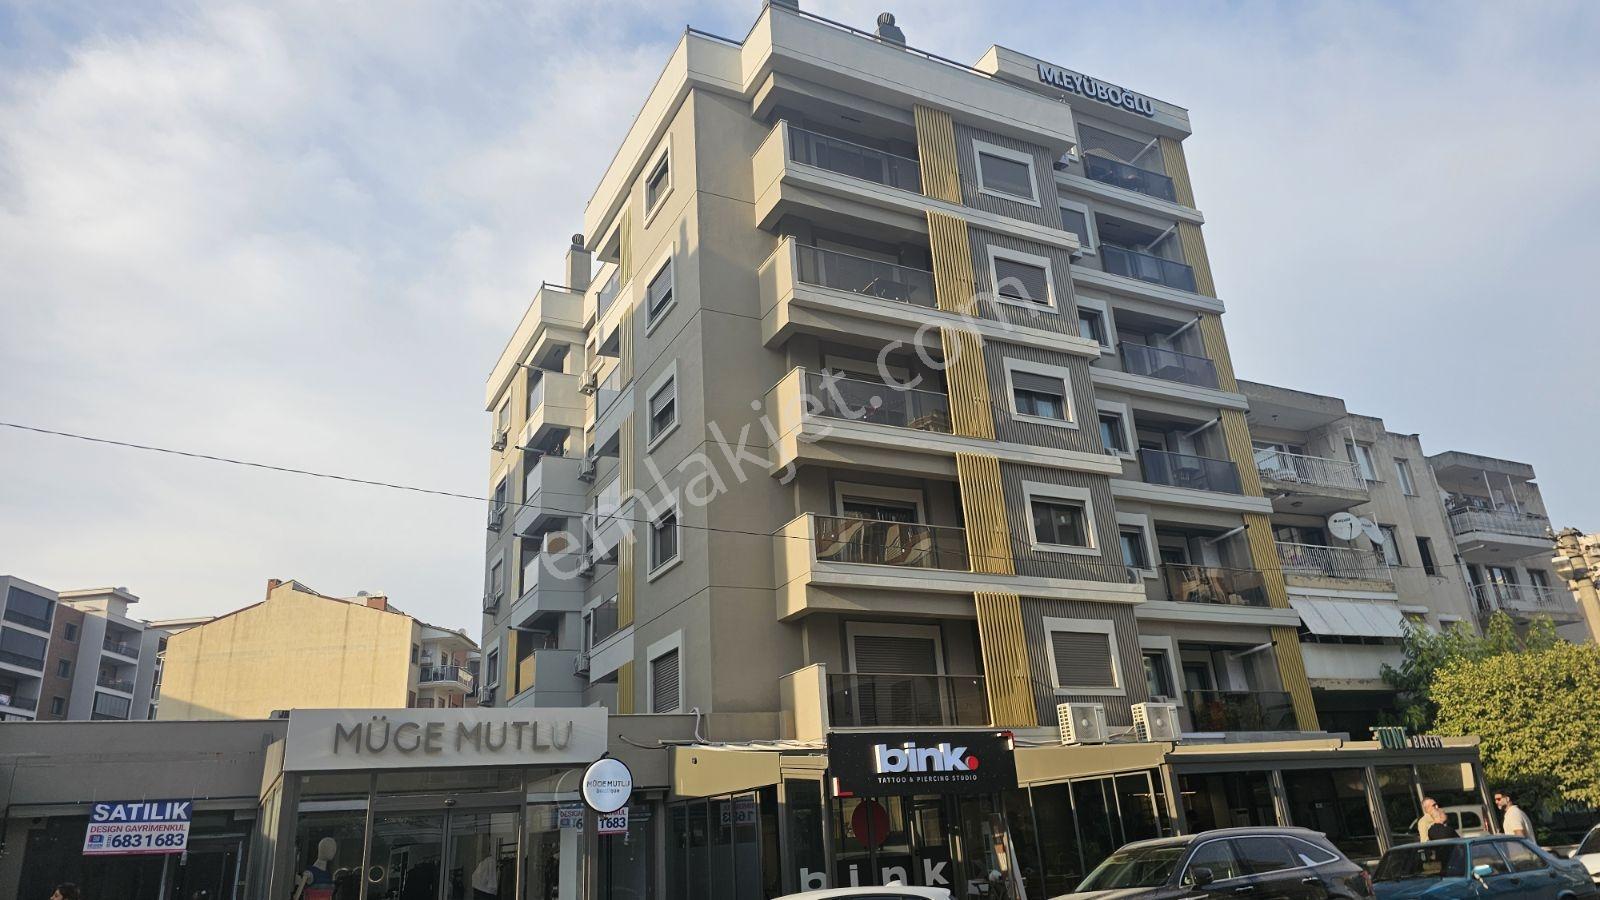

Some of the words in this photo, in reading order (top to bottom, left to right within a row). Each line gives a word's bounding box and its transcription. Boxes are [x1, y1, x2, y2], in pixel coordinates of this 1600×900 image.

[333, 715, 445, 754] MÜGE
[456, 720, 573, 753] MUTLU
[93, 801, 190, 821] SATILIK
[90, 825, 123, 834] DESIGN
